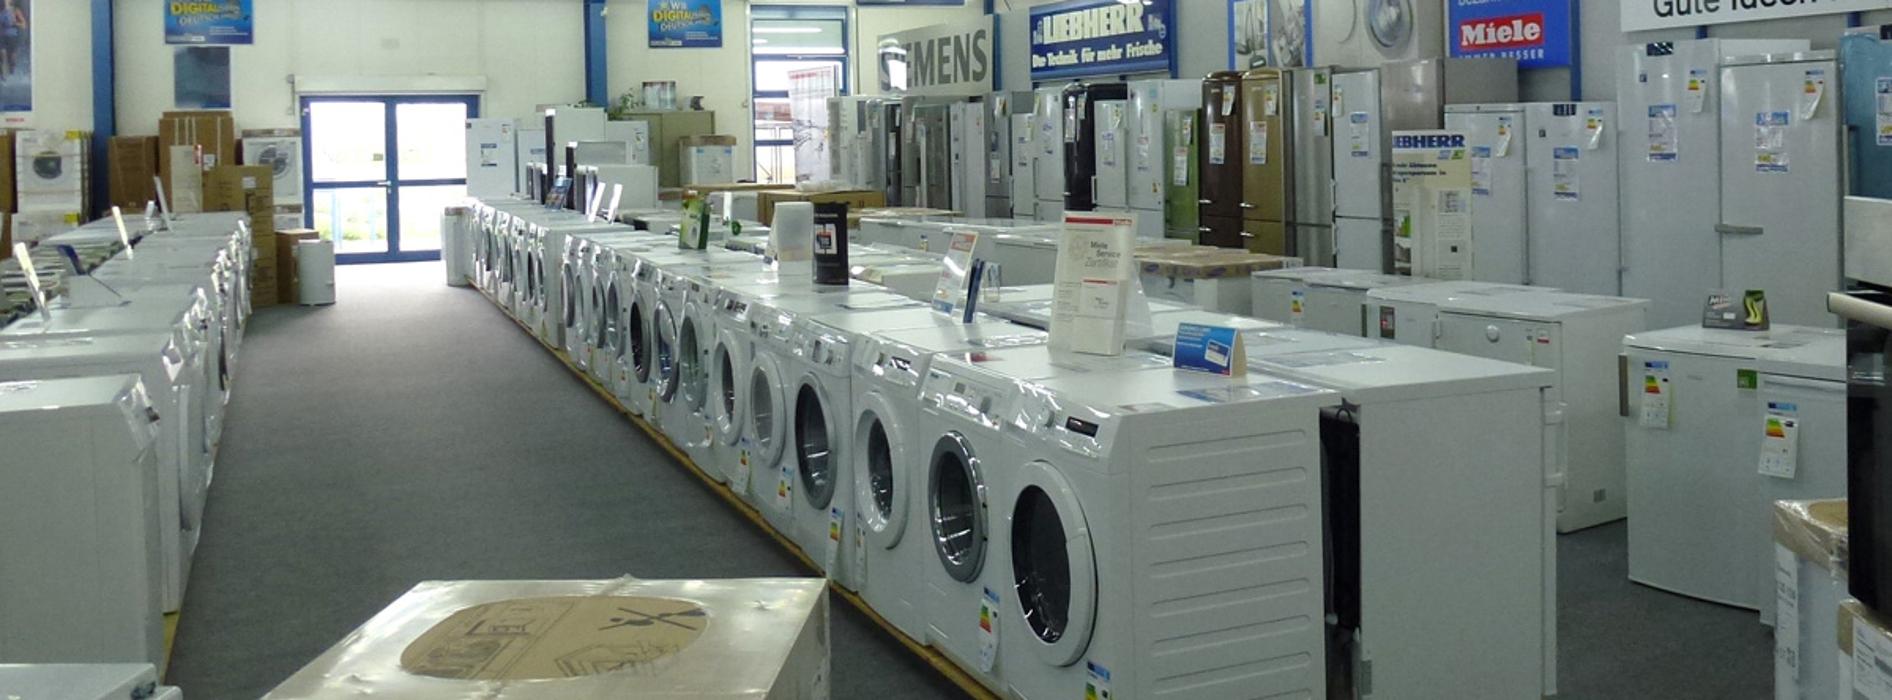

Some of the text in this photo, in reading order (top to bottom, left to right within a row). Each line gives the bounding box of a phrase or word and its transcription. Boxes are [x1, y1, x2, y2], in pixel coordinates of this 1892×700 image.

[172, 1, 219, 16] DIGITAL
[653, 9, 692, 24] DIGITAL
[1043, 2, 1144, 45] LIEBHERR
[1461, 20, 1541, 46] Miele
[880, 29, 988, 92] SEMENS
[1032, 39, 1163, 68] Die Technik für mehr Frische
[1392, 134, 1466, 148] IEBHERR
